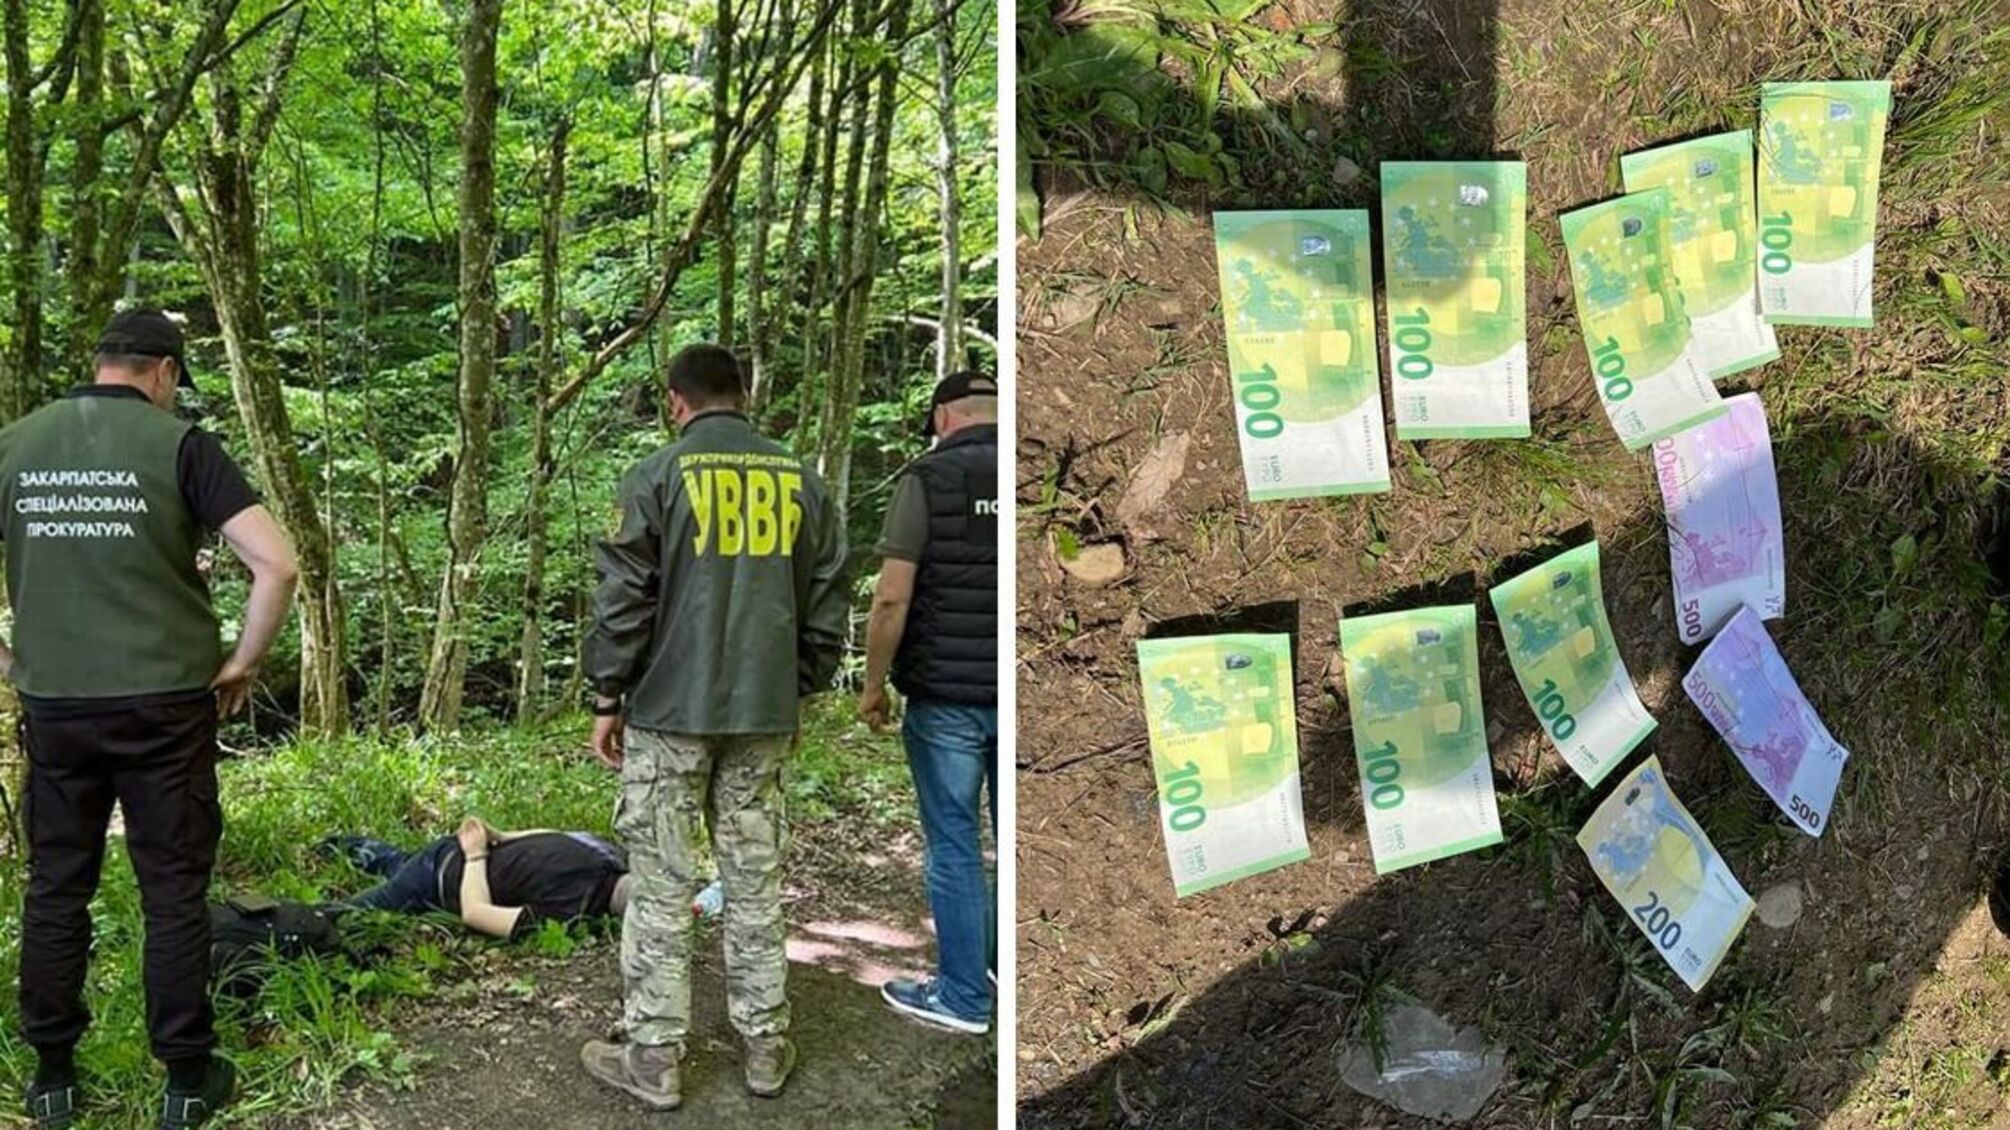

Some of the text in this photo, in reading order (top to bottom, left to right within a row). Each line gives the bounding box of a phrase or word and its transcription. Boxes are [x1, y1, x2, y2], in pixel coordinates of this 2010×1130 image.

[1761, 209, 1792, 274] 100
[1393, 306, 1434, 380] 100
[1594, 335, 1633, 401] 100
[1238, 362, 1284, 439] 100
[18, 471, 139, 488] ЗАКАРПАТСЬКА
[1655, 436, 1678, 466] 00
[15, 493, 149, 514] СПЕЦІАЛІЗОВАНА
[26, 522, 135, 537] ПРОКУРАТУРА
[682, 468, 804, 556] УВВБ
[1682, 598, 1702, 638] 500
[1533, 678, 1576, 741] 100
[1687, 670, 1715, 710] 500
[1163, 760, 1207, 832] 100
[1363, 739, 1405, 810] 100
[1789, 793, 1820, 829] 500
[1633, 891, 1682, 950] 200
